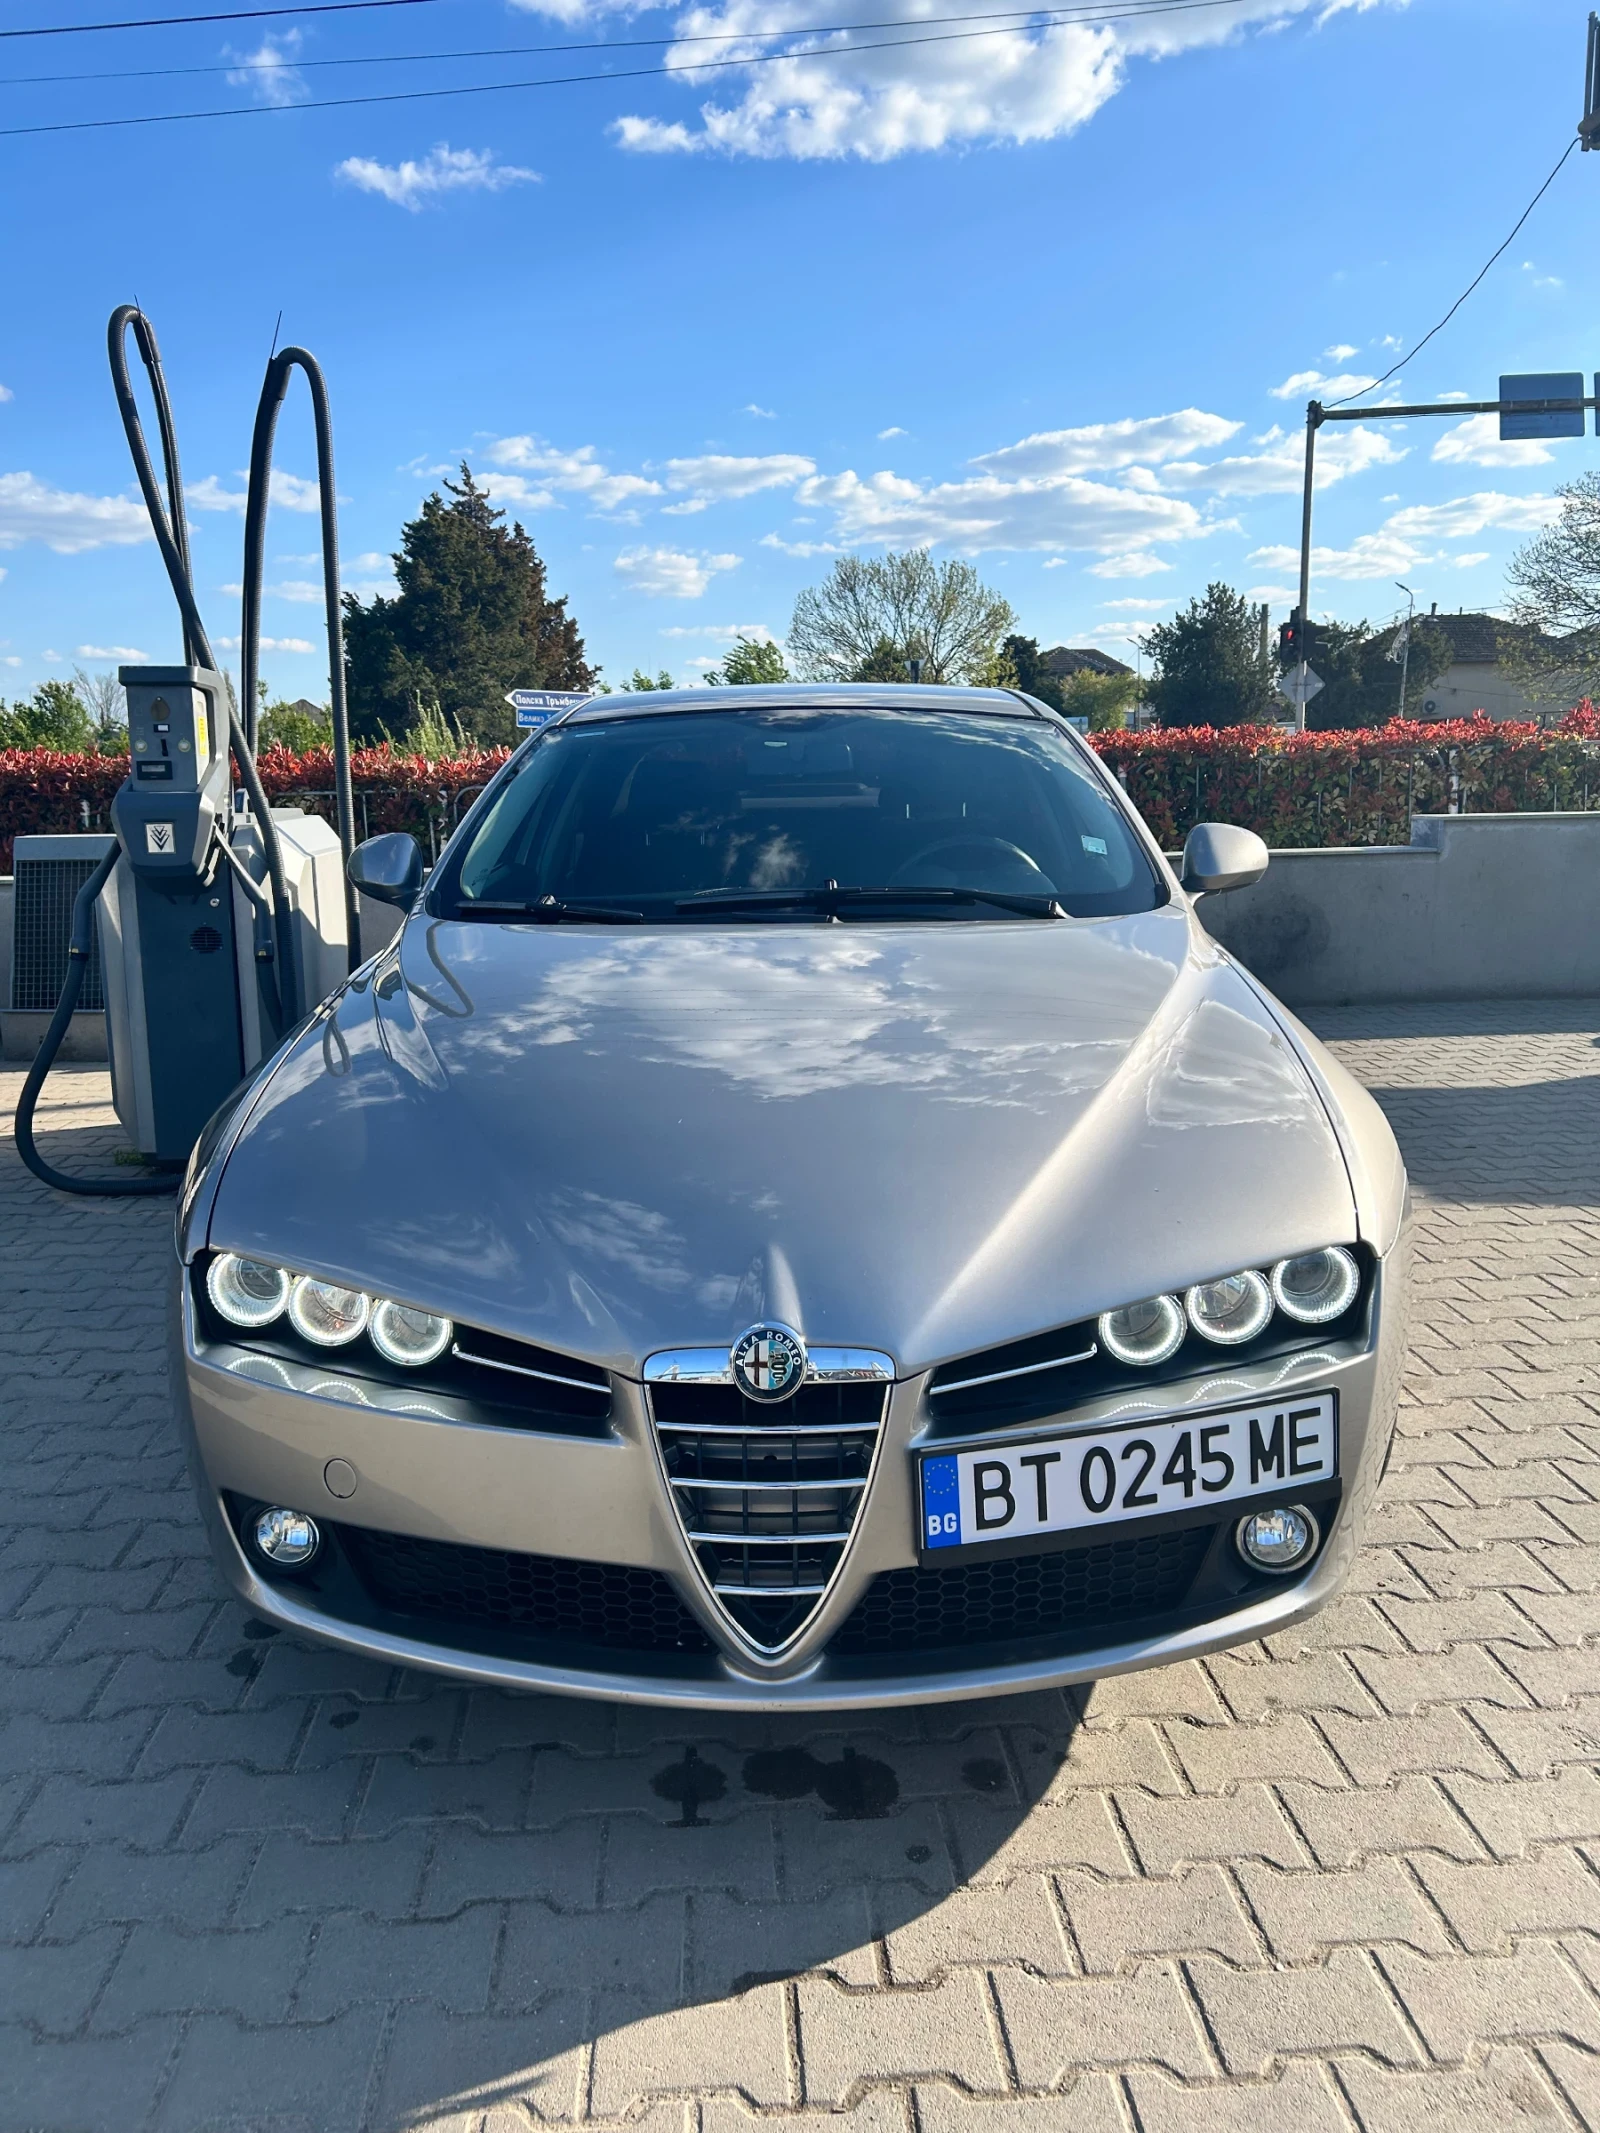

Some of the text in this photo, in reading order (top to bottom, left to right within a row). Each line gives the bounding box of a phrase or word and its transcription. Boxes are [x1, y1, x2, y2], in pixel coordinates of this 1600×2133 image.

[515, 694, 543, 705] Полски
[518, 712, 545, 723] Велико
[735, 1331, 801, 1367] ALFA ROMEO
[973, 1406, 1324, 1531] BT 0245 ME
[927, 1512, 957, 1537] BG
